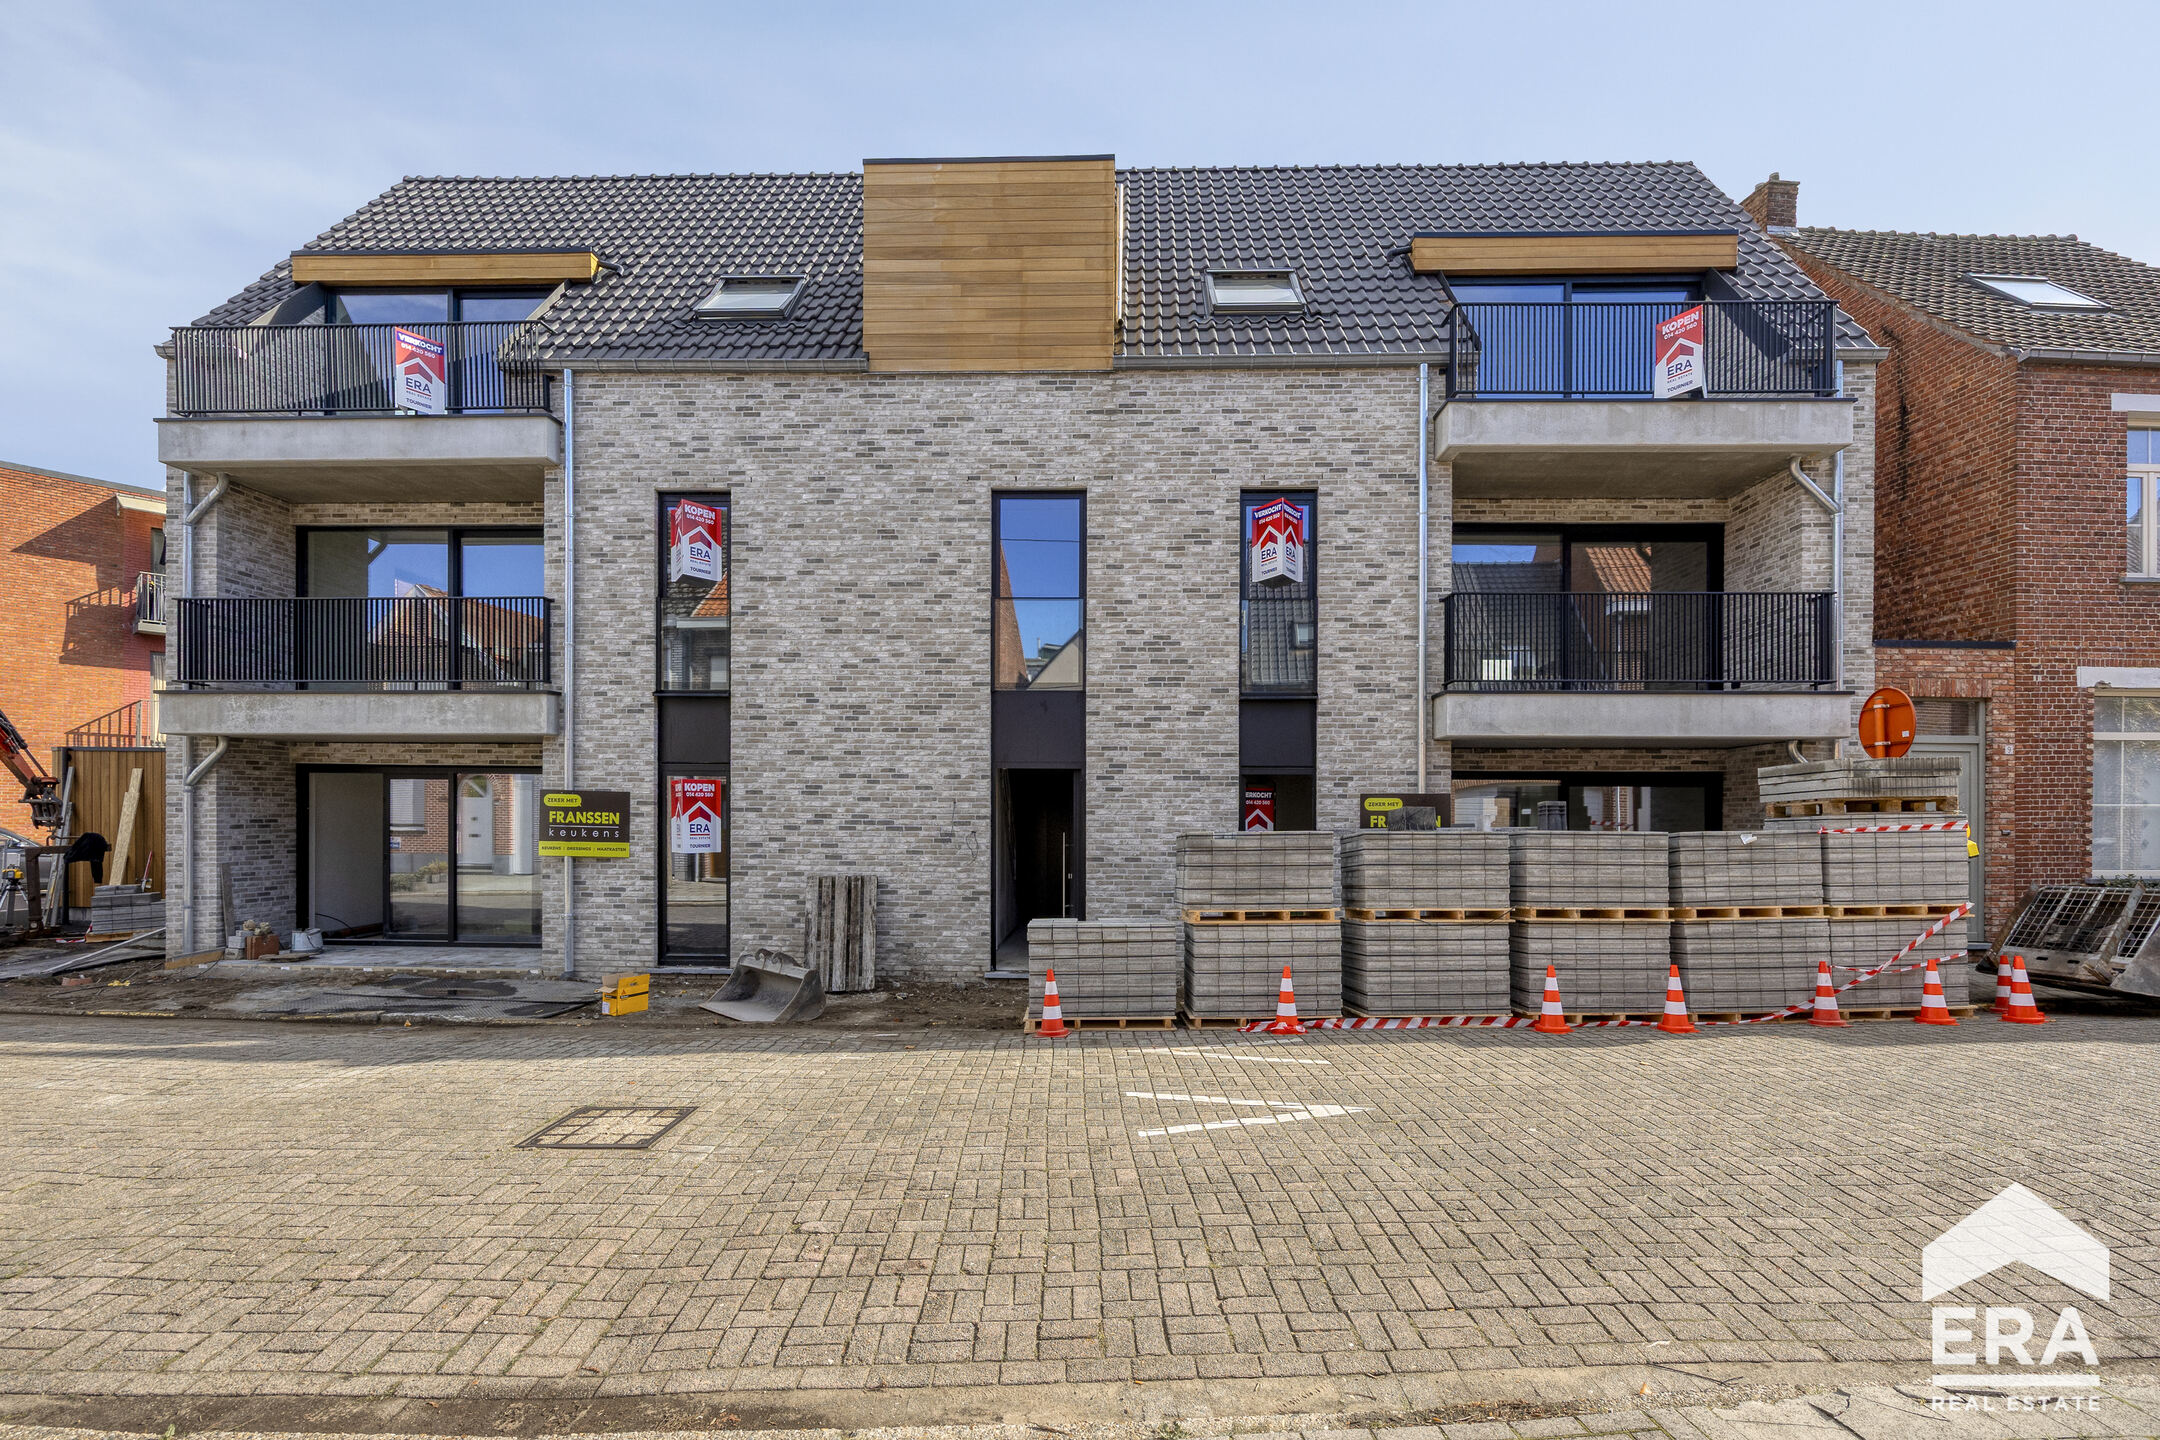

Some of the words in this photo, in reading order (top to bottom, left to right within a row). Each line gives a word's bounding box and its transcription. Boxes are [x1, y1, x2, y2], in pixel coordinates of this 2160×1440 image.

[1662, 311, 1699, 335] KOPEN
[1663, 332, 1674, 340] 014
[1674, 327, 1686, 336] 420
[398, 332, 442, 354] VERKOCHT
[1667, 359, 1693, 377] ERA
[405, 377, 431, 394] ERA
[1667, 380, 1694, 393] TOURNIER
[406, 397, 433, 410] TOURNIER
[684, 503, 716, 520] KOPEN
[1254, 503, 1282, 519] VERKOCHT
[690, 546, 711, 560] ERA
[1261, 547, 1278, 560] ERA
[1285, 546, 1296, 559] ERA
[684, 783, 715, 792] KOPEN
[549, 810, 620, 825] FRANSSEN
[549, 828, 620, 838] keukens
[689, 823, 711, 833] ERA
